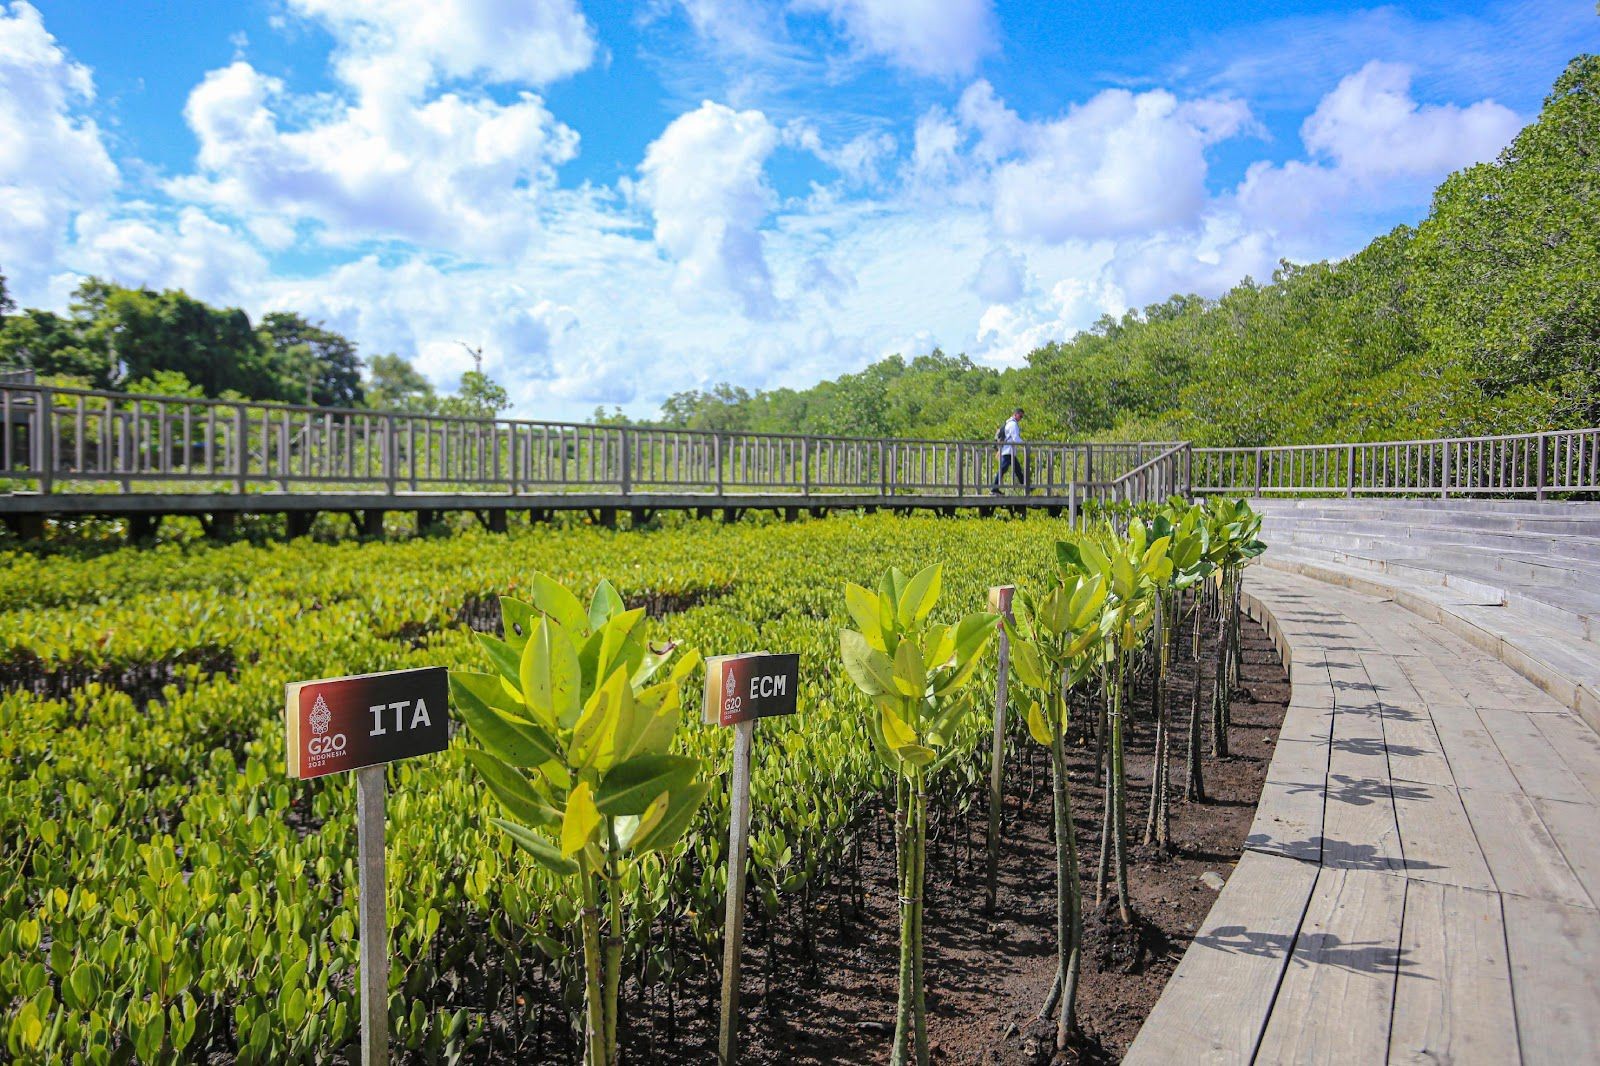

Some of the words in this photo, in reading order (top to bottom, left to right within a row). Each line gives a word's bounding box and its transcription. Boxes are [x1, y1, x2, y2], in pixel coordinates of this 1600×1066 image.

[750, 675, 787, 699] ECM
[725, 697, 741, 710] G20
[369, 698, 431, 736] ITA
[308, 733, 346, 754] G20
[308, 751, 347, 762] INDONESIA
[308, 760, 326, 768] 2022
